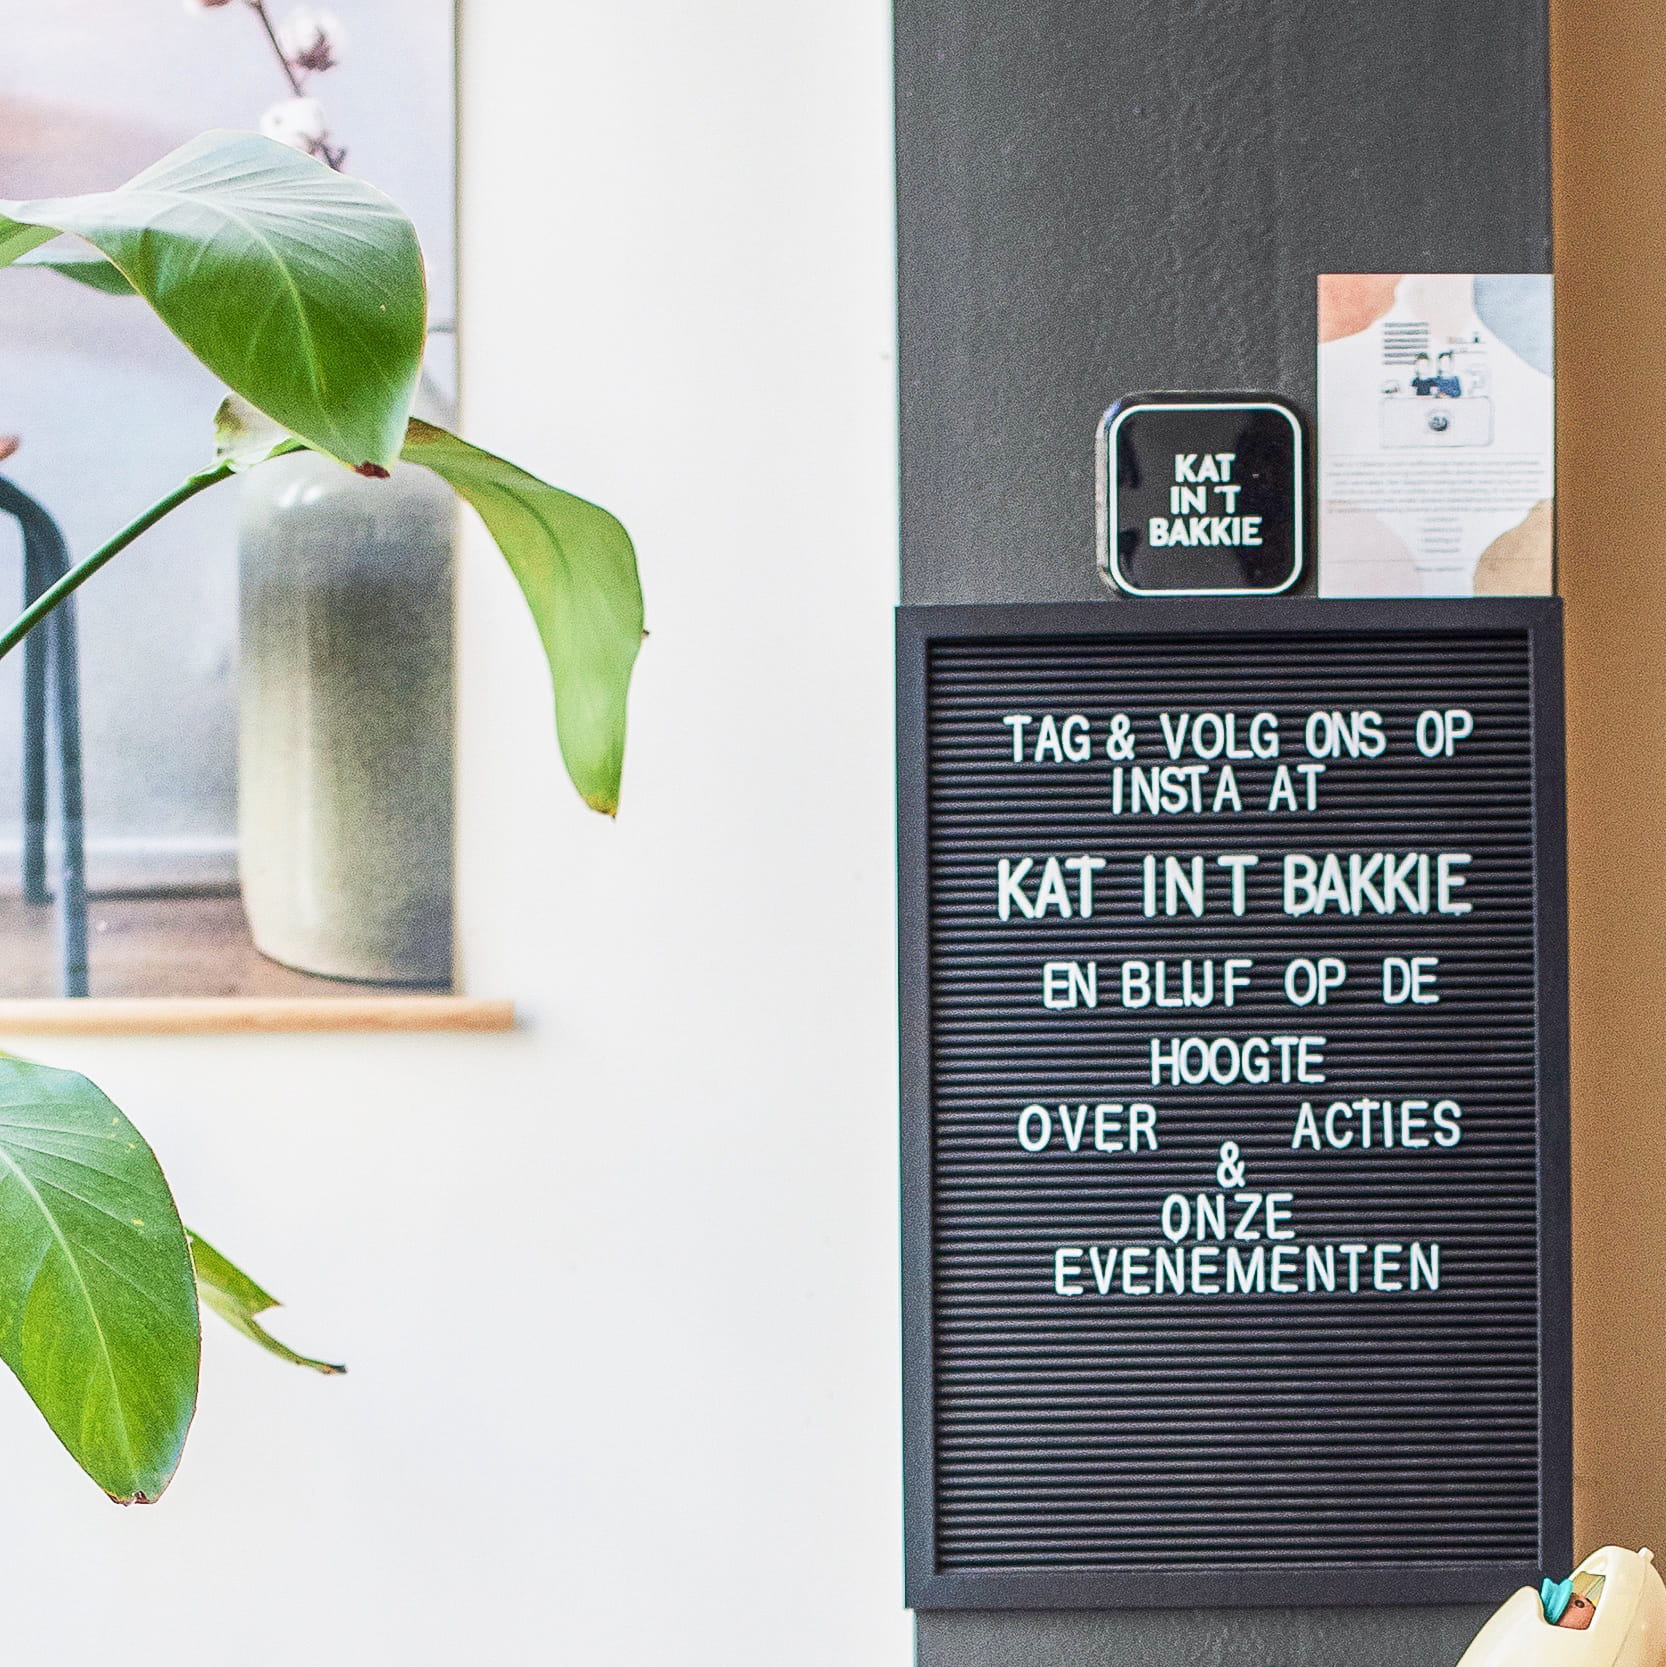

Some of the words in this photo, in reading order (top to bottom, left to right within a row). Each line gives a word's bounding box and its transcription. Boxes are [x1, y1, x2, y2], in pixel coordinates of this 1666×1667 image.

[1174, 453, 1236, 483] KAT
[1170, 485, 1207, 515] IN
[1149, 516, 1263, 547] BAKKIE
[1003, 714, 1091, 764] TAG
[1105, 713, 1136, 761] &
[1159, 712, 1279, 761] VOLG
[1305, 710, 1387, 759] ONS
[1416, 709, 1474, 758] OP
[1112, 764, 1242, 816] INSTA
[1268, 763, 1326, 812] AT
[997, 853, 1107, 922] KAT
[1283, 852, 1472, 918] BAKKIE
[1043, 961, 1097, 1011] EN
[1121, 958, 1253, 1009] BLIJF
[1284, 957, 1346, 1007] OP
[1382, 956, 1440, 1004] DE
[1150, 1035, 1327, 1086] HOOGTE
[1017, 1103, 1158, 1154] OVER
[1291, 1097, 1462, 1151] ACTIES
[1216, 1140, 1246, 1189] &
[1161, 1192, 1296, 1244] ONZE
[1054, 1242, 1440, 1297] EVENEMENTEN
